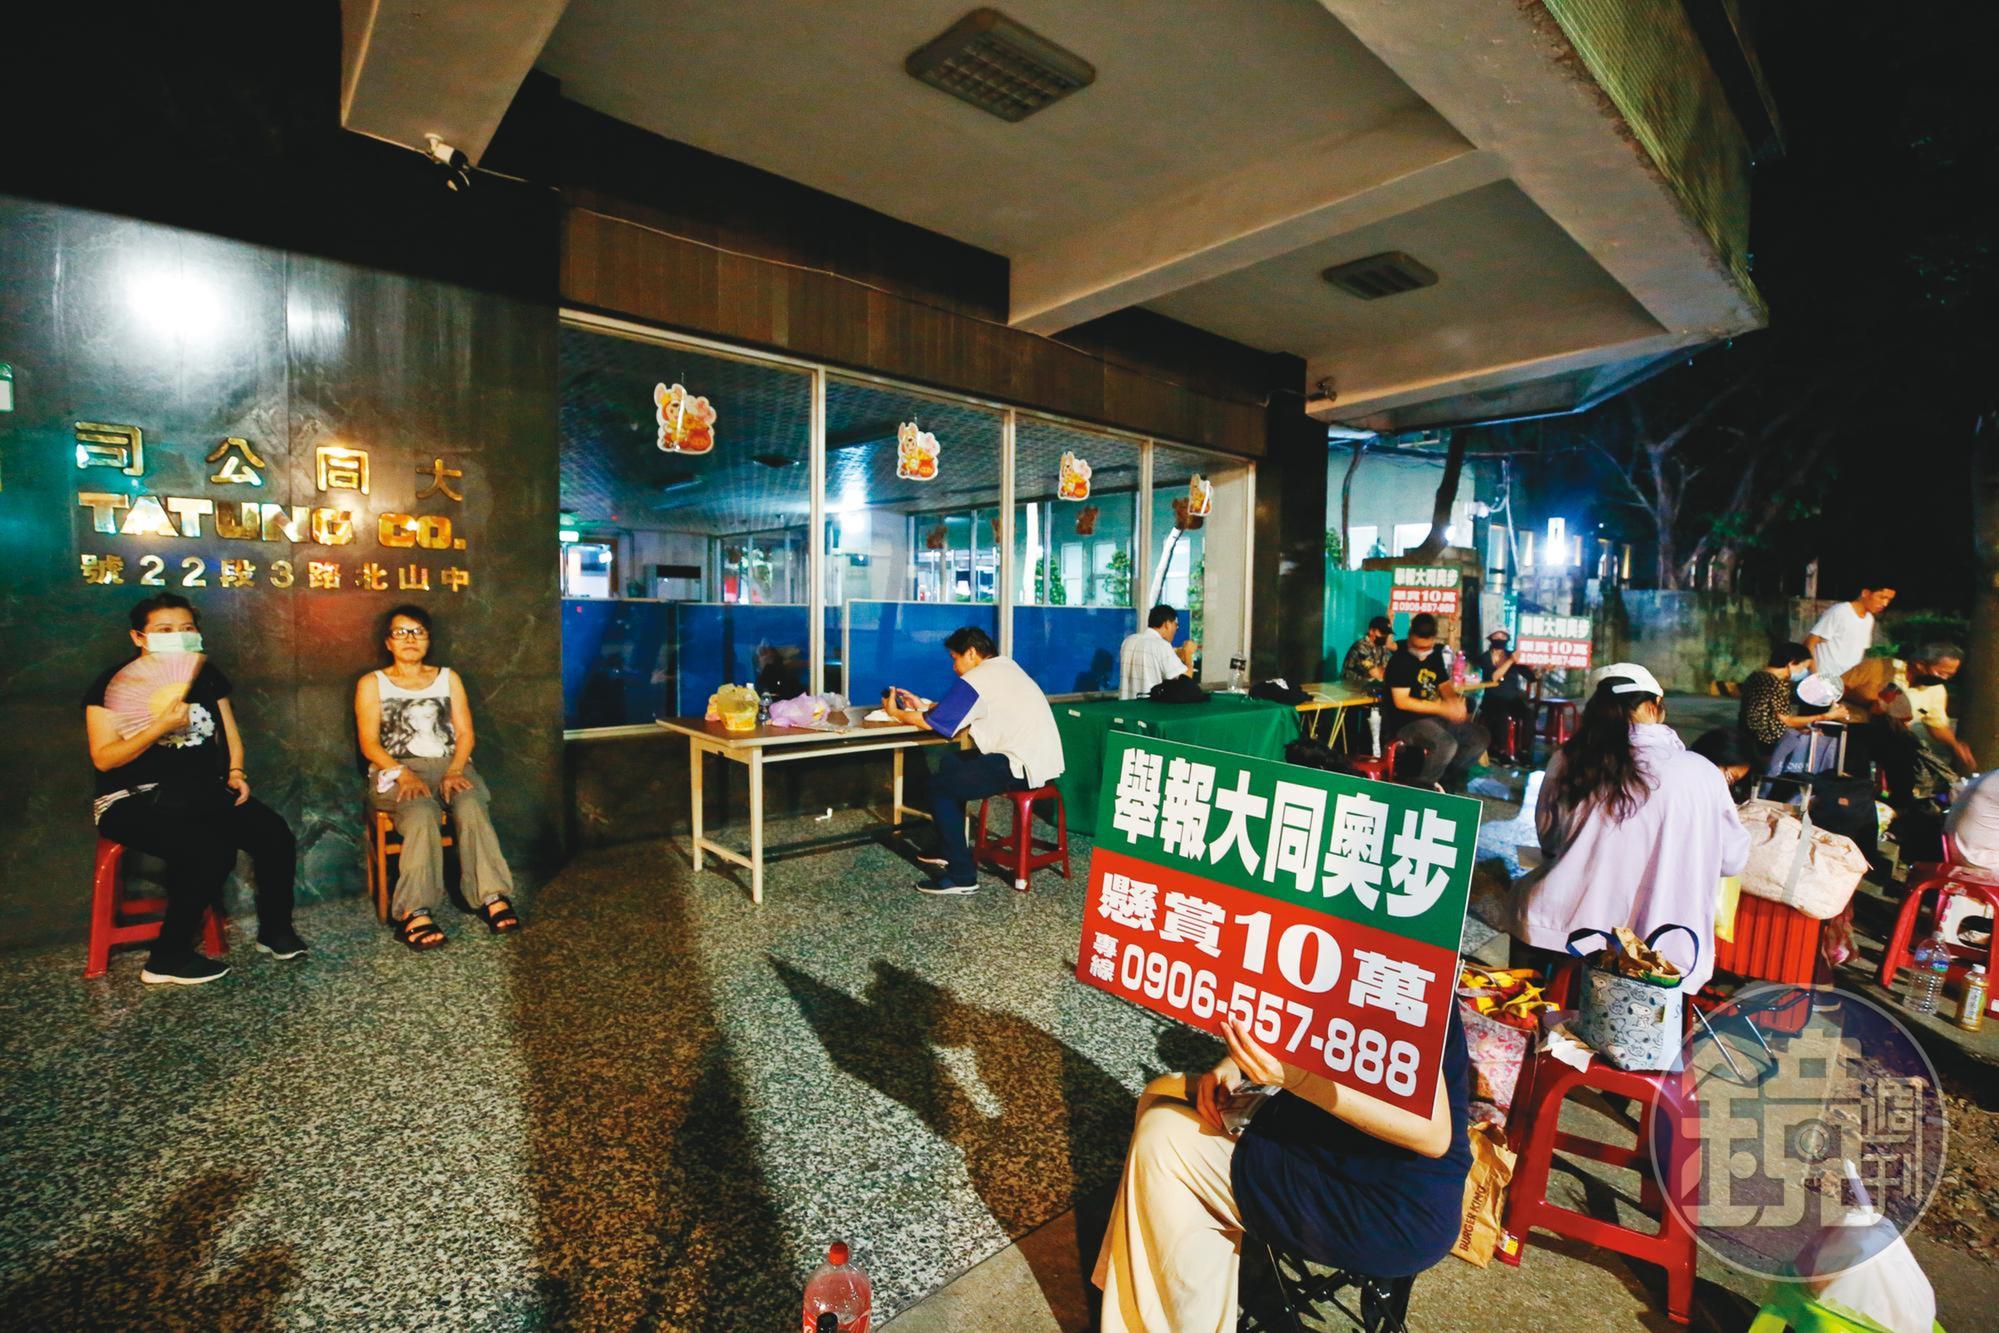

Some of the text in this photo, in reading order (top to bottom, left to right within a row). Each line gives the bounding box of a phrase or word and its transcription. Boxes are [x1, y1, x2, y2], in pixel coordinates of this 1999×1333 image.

[78, 492, 467, 550] TATUNG CO.
[1113, 746, 1458, 918] 舉報大同奧步
[1097, 872, 1436, 1028] 懸賞10萬
[1121, 944, 1421, 1097] 0906-557-888
[1459, 1212, 1477, 1251] BURGER
